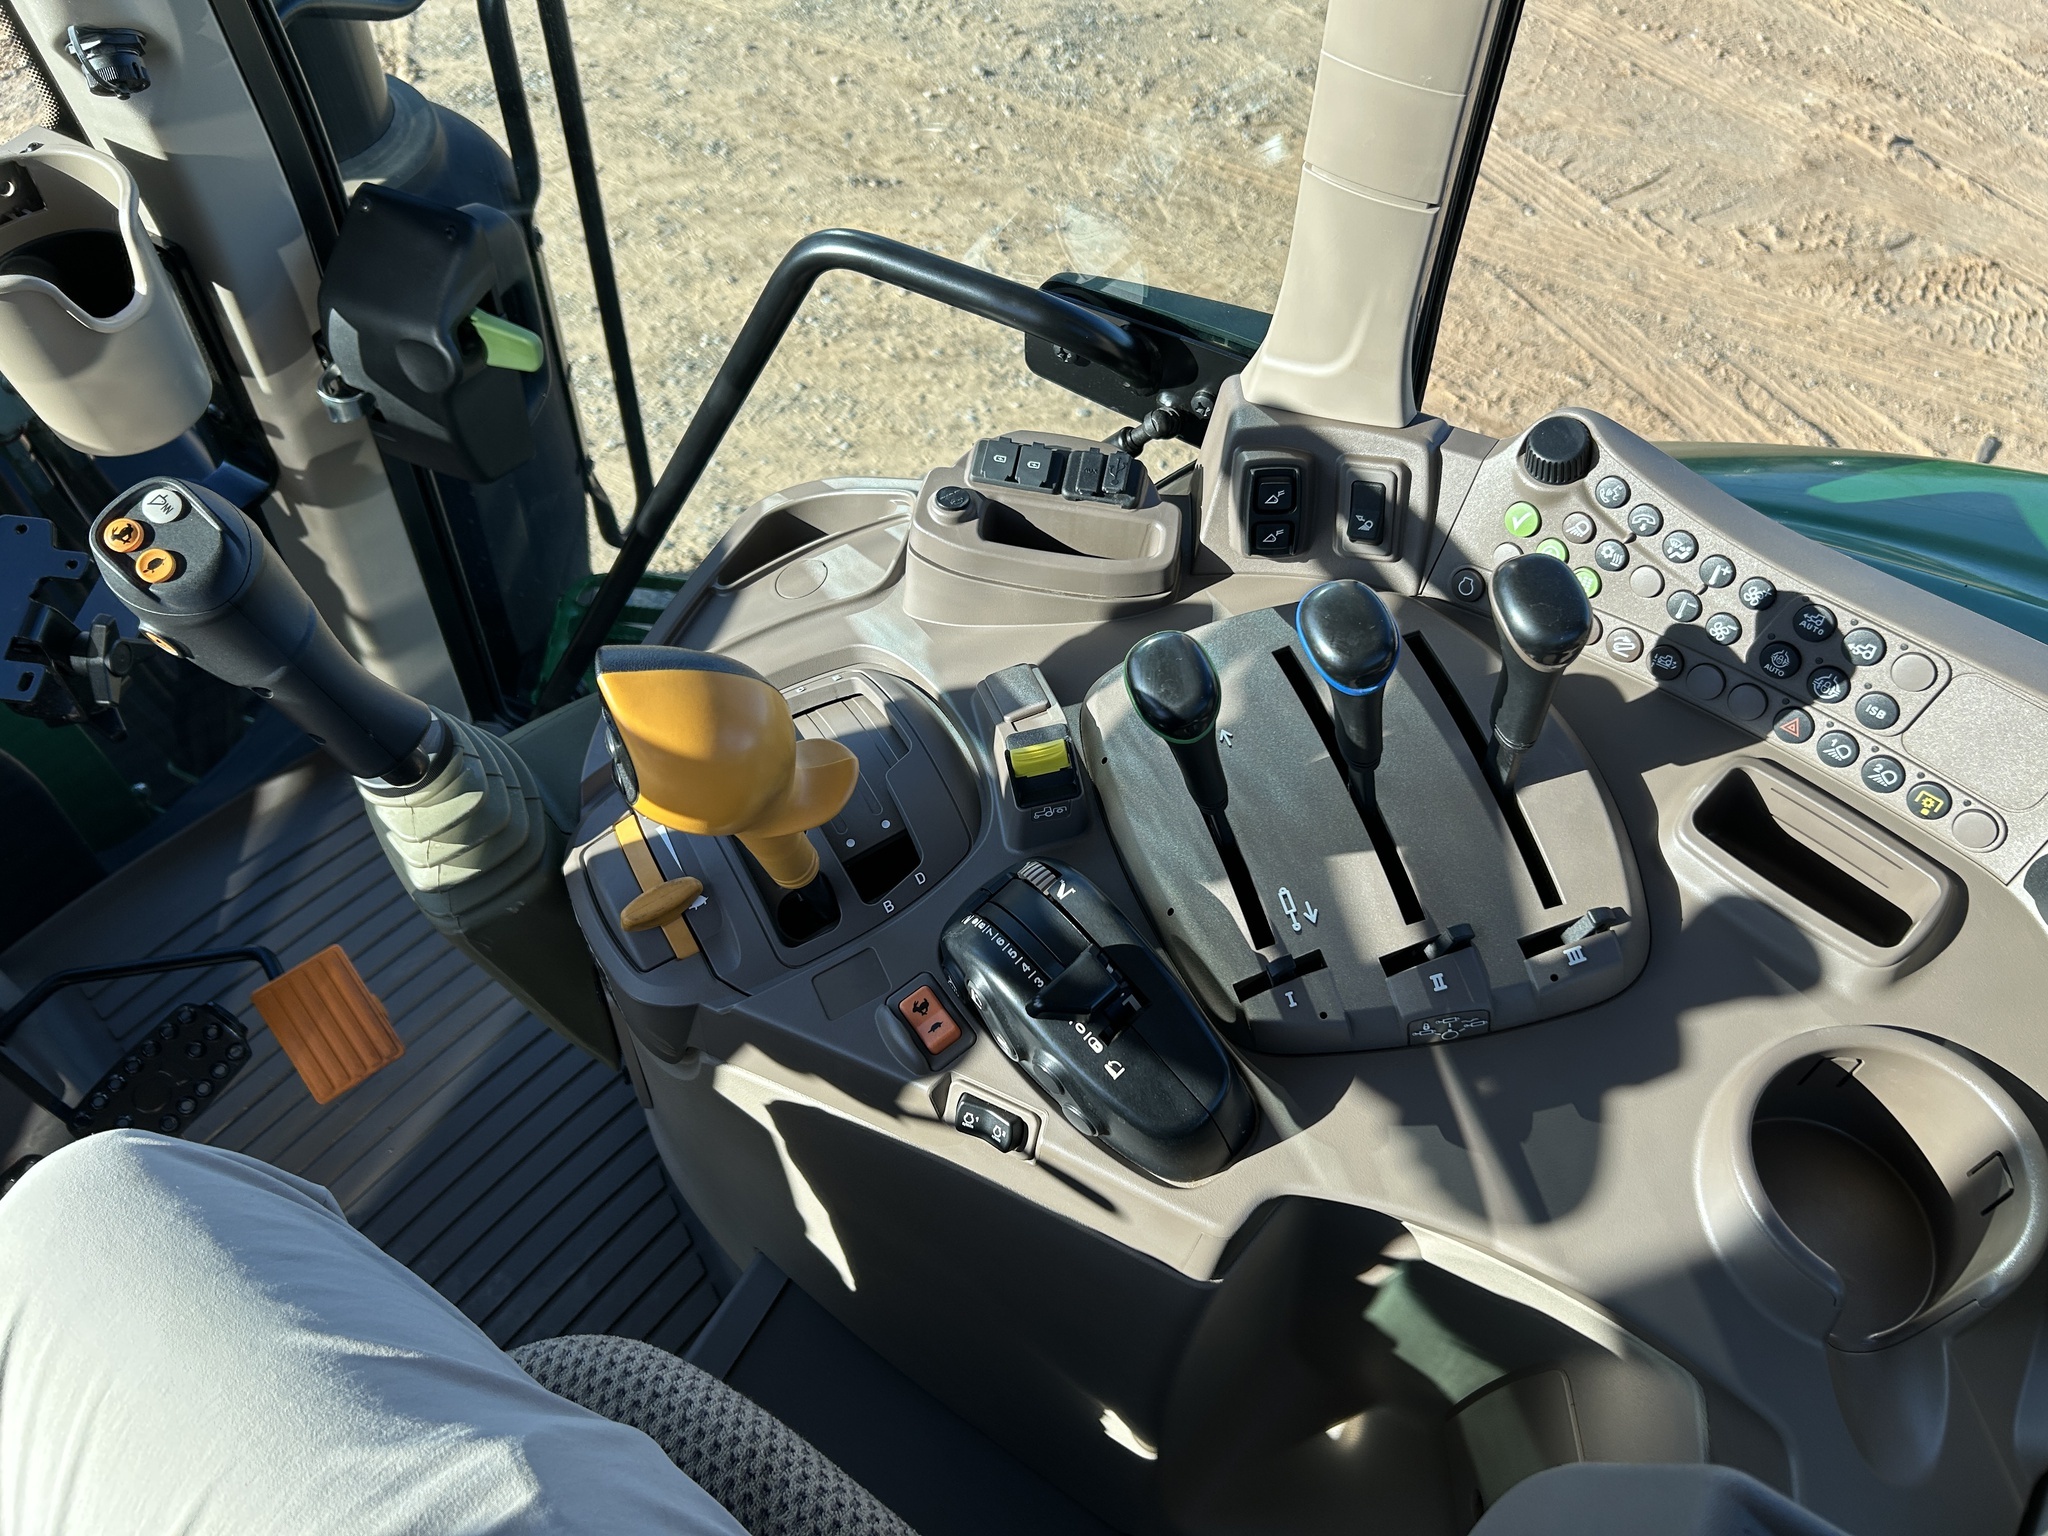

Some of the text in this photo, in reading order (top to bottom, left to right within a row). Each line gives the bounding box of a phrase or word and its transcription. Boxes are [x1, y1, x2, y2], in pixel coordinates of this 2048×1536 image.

[1799, 620, 1824, 636] AUTO
[1763, 663, 1785, 677] AUTO
[1865, 704, 1887, 720] ISB
[1831, 739, 1838, 747] 1
[1873, 764, 1883, 773] 2
[914, 872, 926, 885] D
[883, 900, 895, 913] B
[986, 928, 993, 936] 7
[996, 937, 1005, 946] 6
[1007, 948, 1018, 959] 5
[1563, 945, 1587, 966] III
[1022, 962, 1031, 972] 4
[1034, 977, 1044, 988] 3
[1429, 972, 1448, 992] II
[1284, 991, 1298, 1008] I
